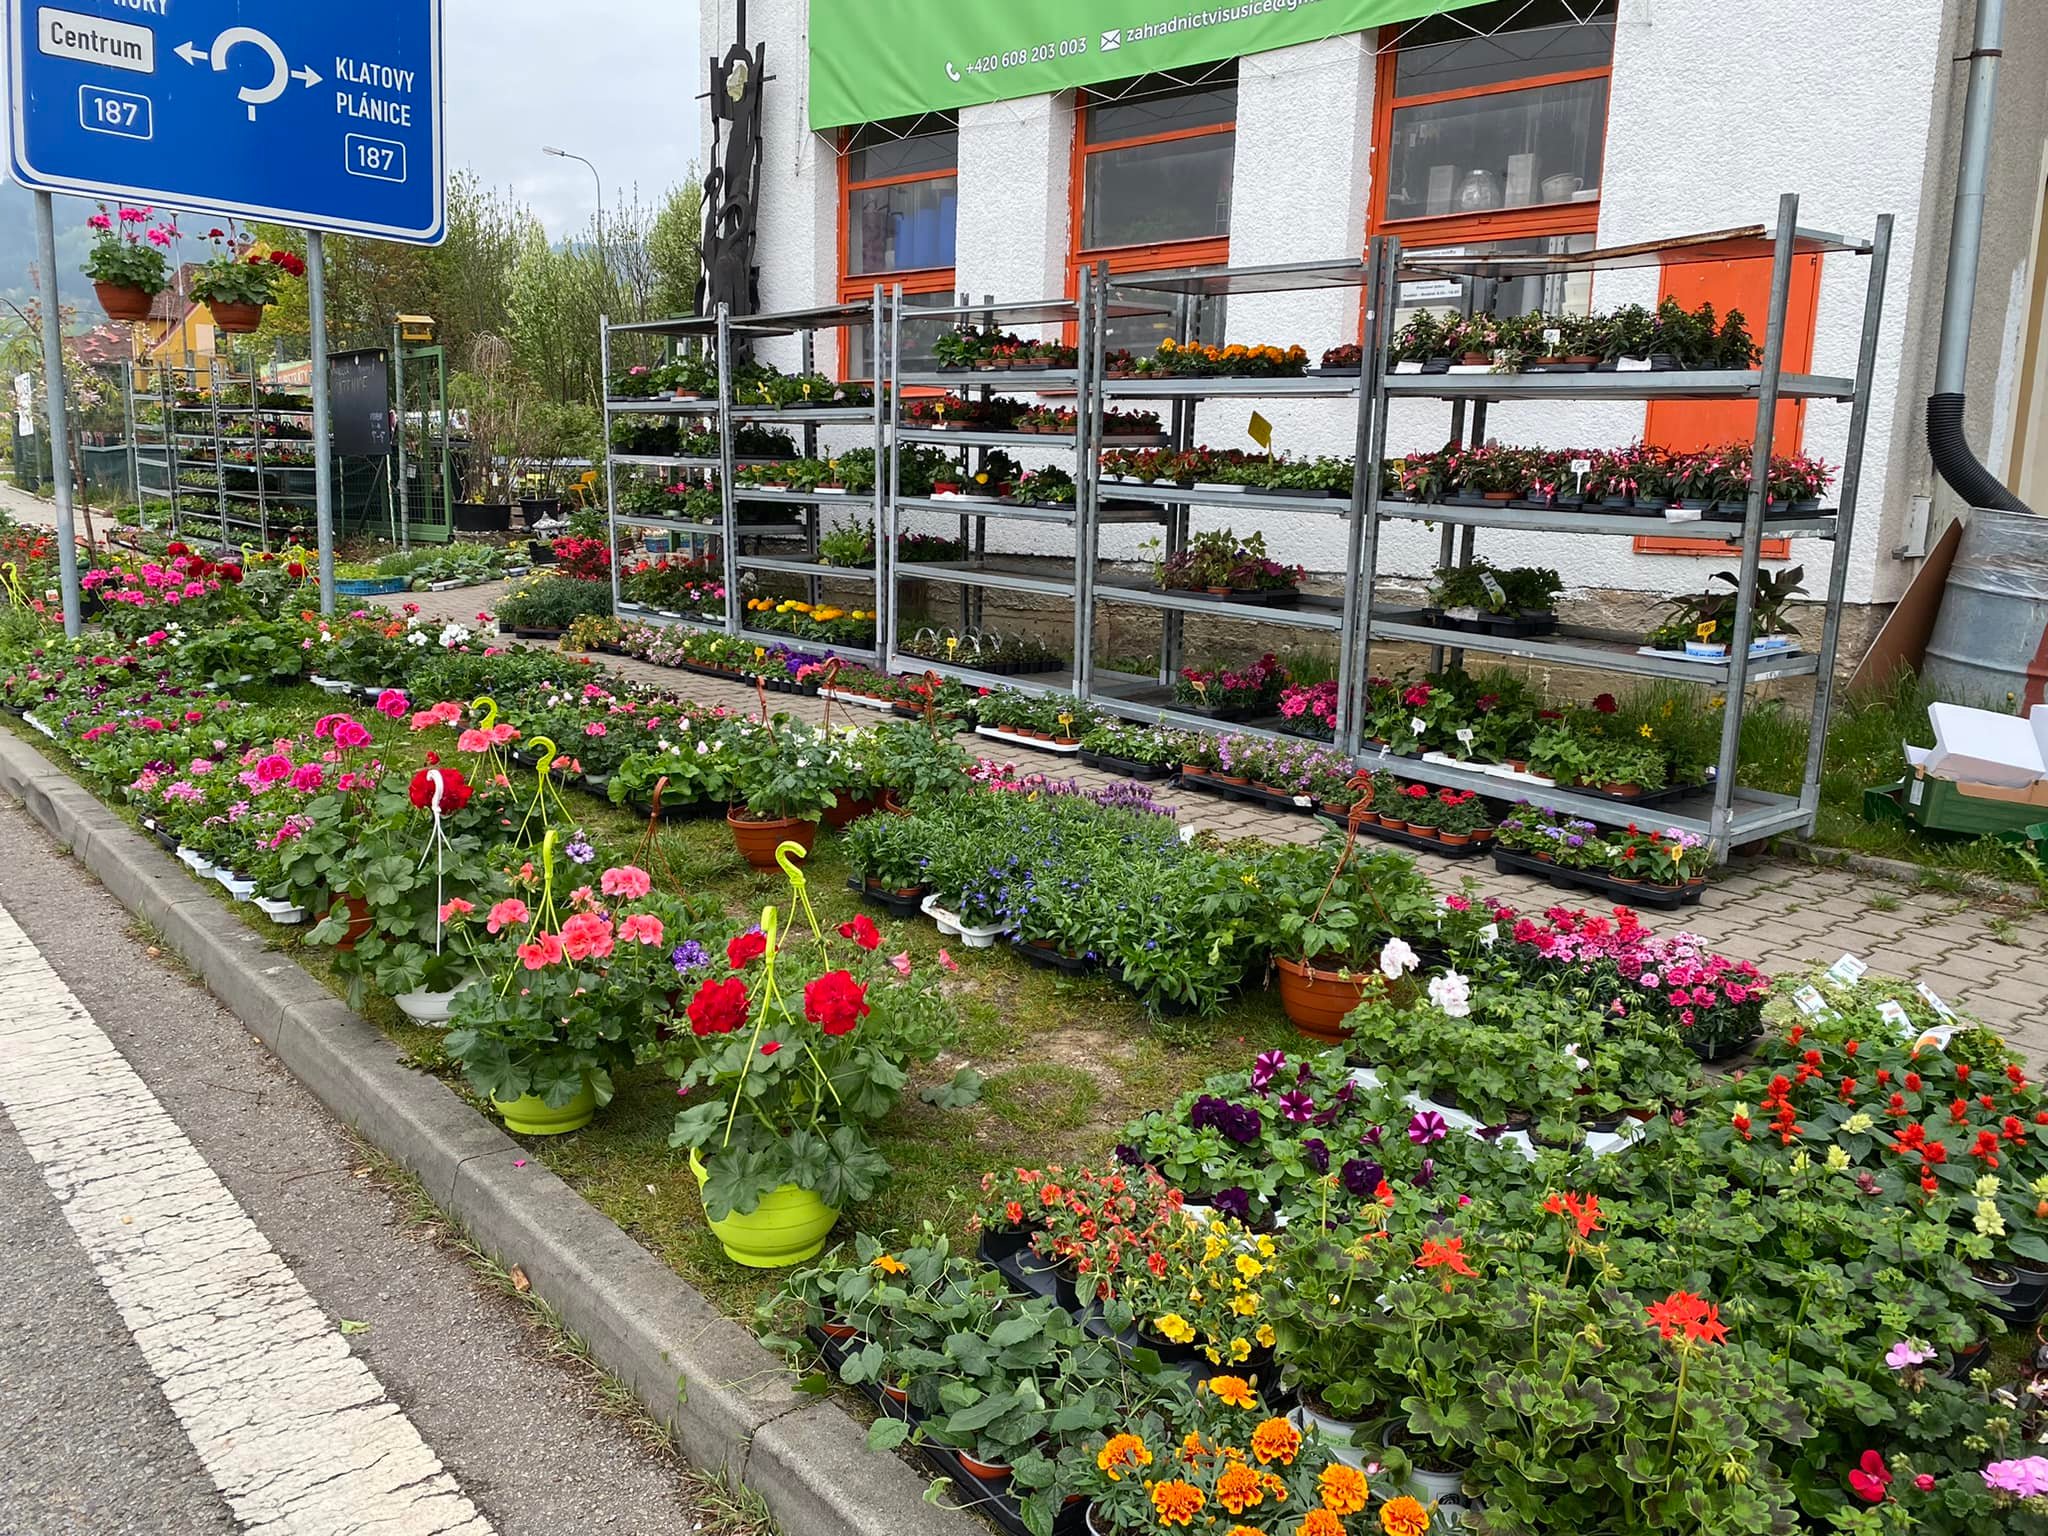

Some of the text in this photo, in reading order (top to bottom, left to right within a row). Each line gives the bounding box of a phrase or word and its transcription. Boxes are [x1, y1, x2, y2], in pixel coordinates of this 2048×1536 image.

[50, 21, 143, 61] Centrum
[966, 37, 1087, 75] +420 608 203 003
[335, 56, 415, 93] KLATOVY
[92, 96, 139, 127] 187
[335, 91, 412, 128] PLÁNICE
[357, 144, 395, 171] 187
